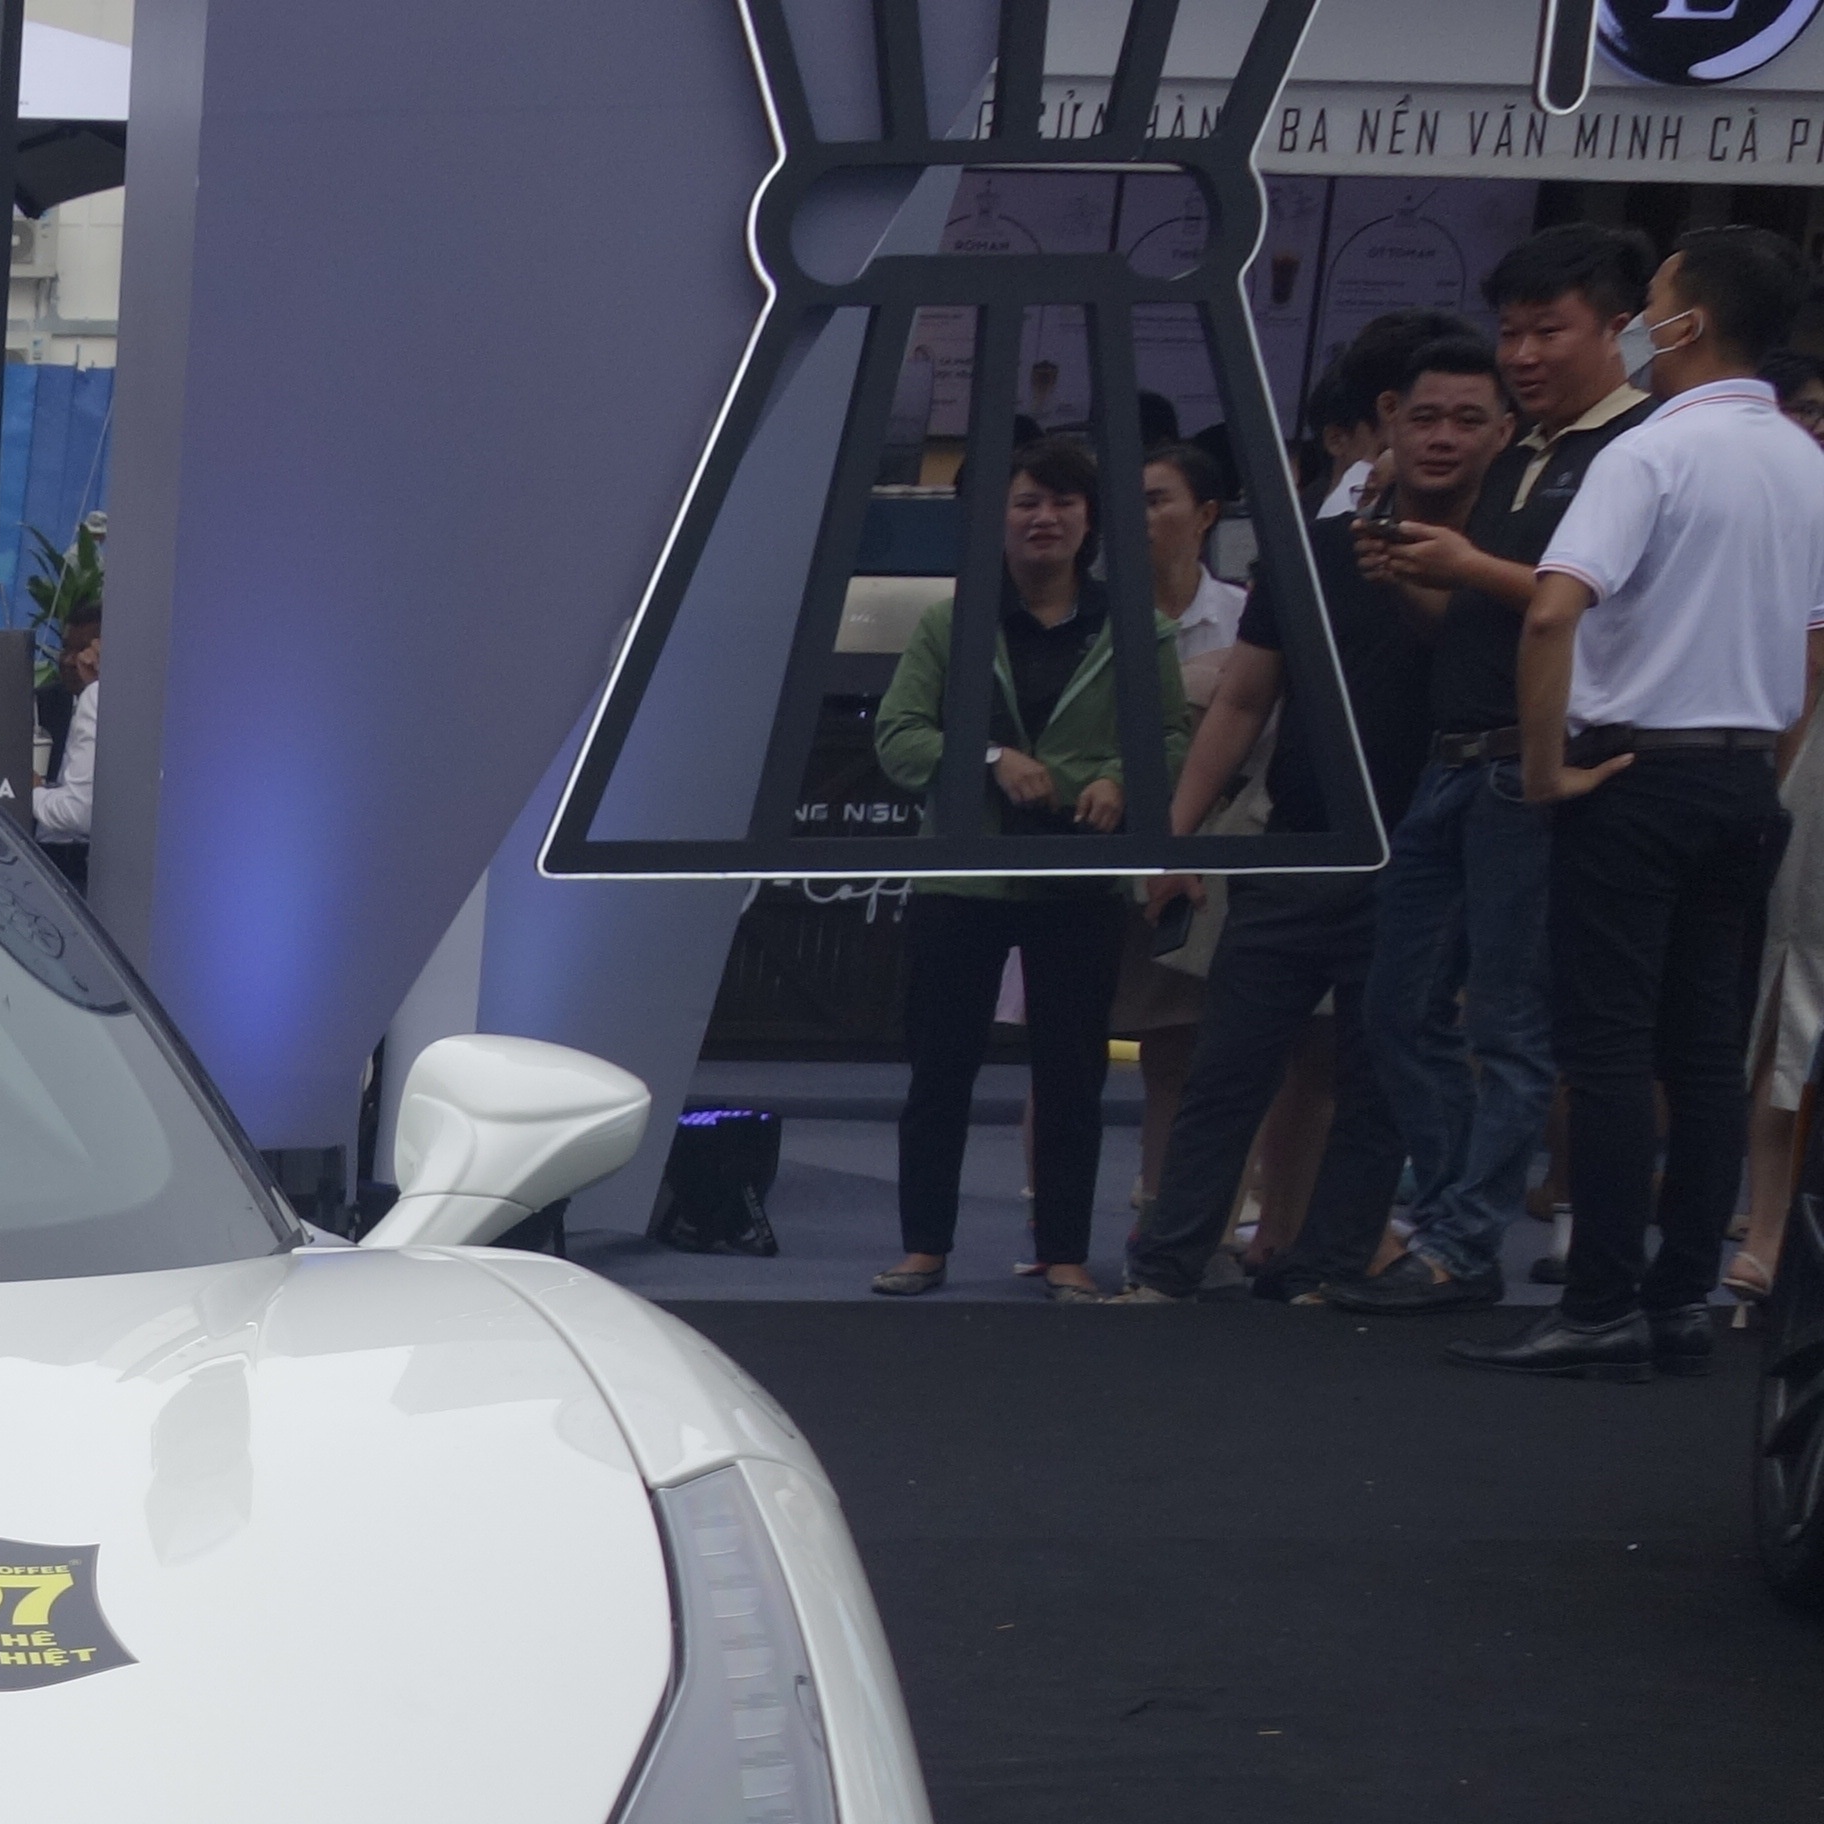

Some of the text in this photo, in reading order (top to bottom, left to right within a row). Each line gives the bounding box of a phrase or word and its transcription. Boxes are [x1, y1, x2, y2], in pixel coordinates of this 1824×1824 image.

[1278, 107, 1328, 154] BA
[1468, 103, 1546, 157] VĂN
[1573, 114, 1684, 162] MINH
[1709, 113, 1757, 164] CÀ
